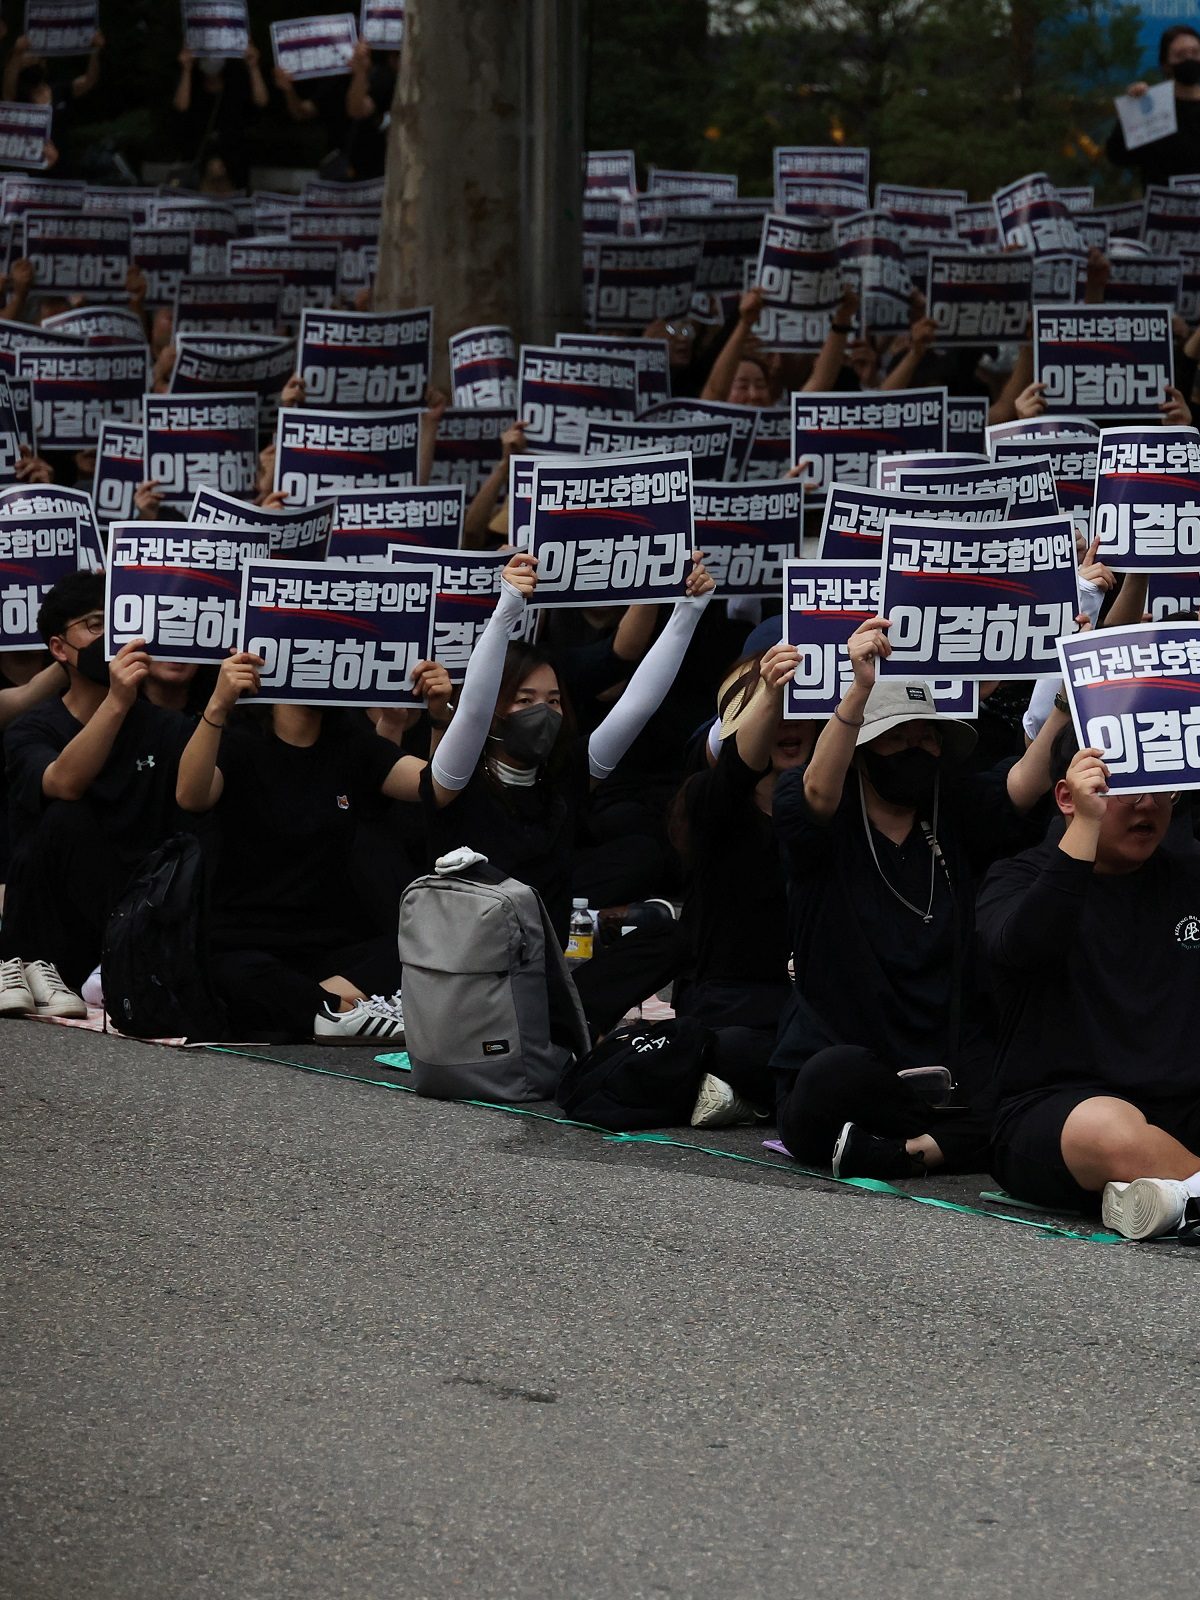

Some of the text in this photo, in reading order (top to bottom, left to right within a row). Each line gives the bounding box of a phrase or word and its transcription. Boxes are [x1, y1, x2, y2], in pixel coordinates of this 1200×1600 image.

[304, 320, 429, 346] 교권보호합의안
[1039, 317, 1166, 342] 교권보호합의안
[21, 359, 144, 381] 교권보호합의안
[303, 363, 427, 404] 의결하라
[524, 357, 635, 391] 교권보호합의안
[1042, 363, 1169, 405] 의결하라
[797, 401, 941, 430] 교권보호합의안
[283, 421, 417, 452] 교권보호합의안
[538, 470, 688, 511] 교권보호합의안
[334, 499, 461, 530] 권보호합의안
[538, 533, 691, 592] 의결하라
[890, 534, 1072, 574] 교권보호합의안
[248, 577, 430, 613] 교권보호합의안
[113, 595, 241, 648] 의결하
[887, 602, 1080, 663] 의결하라
[248, 638, 421, 690] 의결하라
